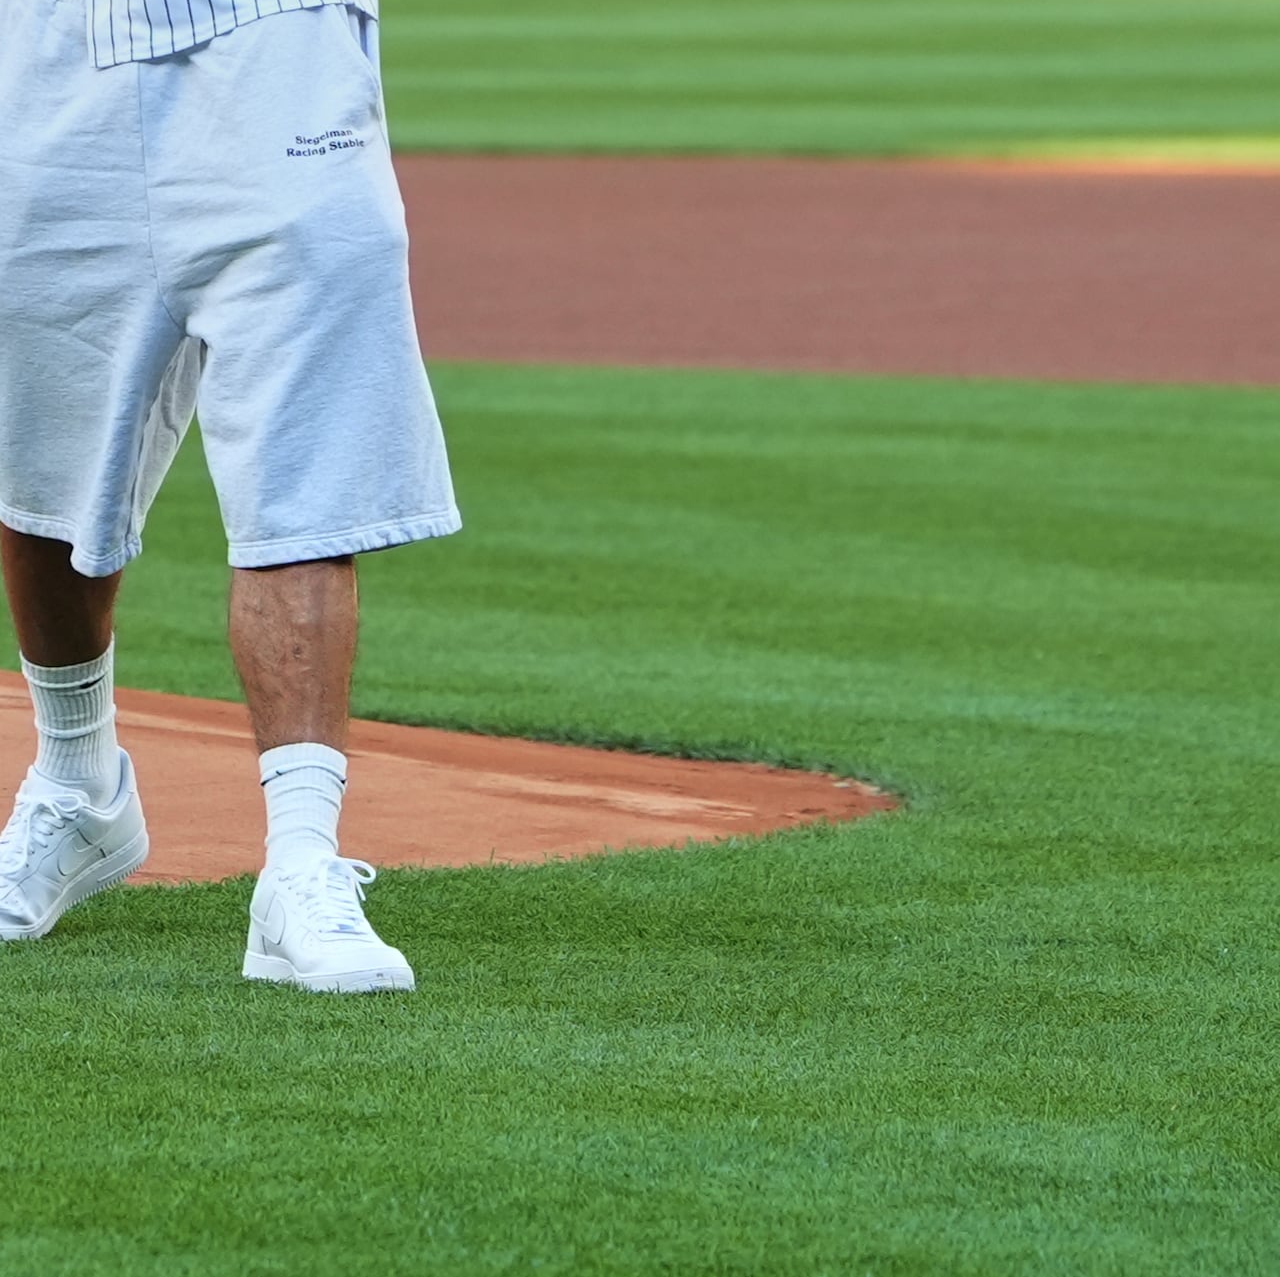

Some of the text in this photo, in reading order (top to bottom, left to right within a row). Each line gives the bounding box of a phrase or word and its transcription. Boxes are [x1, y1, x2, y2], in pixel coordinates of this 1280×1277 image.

[295, 129, 354, 145] Siegelman
[286, 138, 365, 157] Racing Stable
